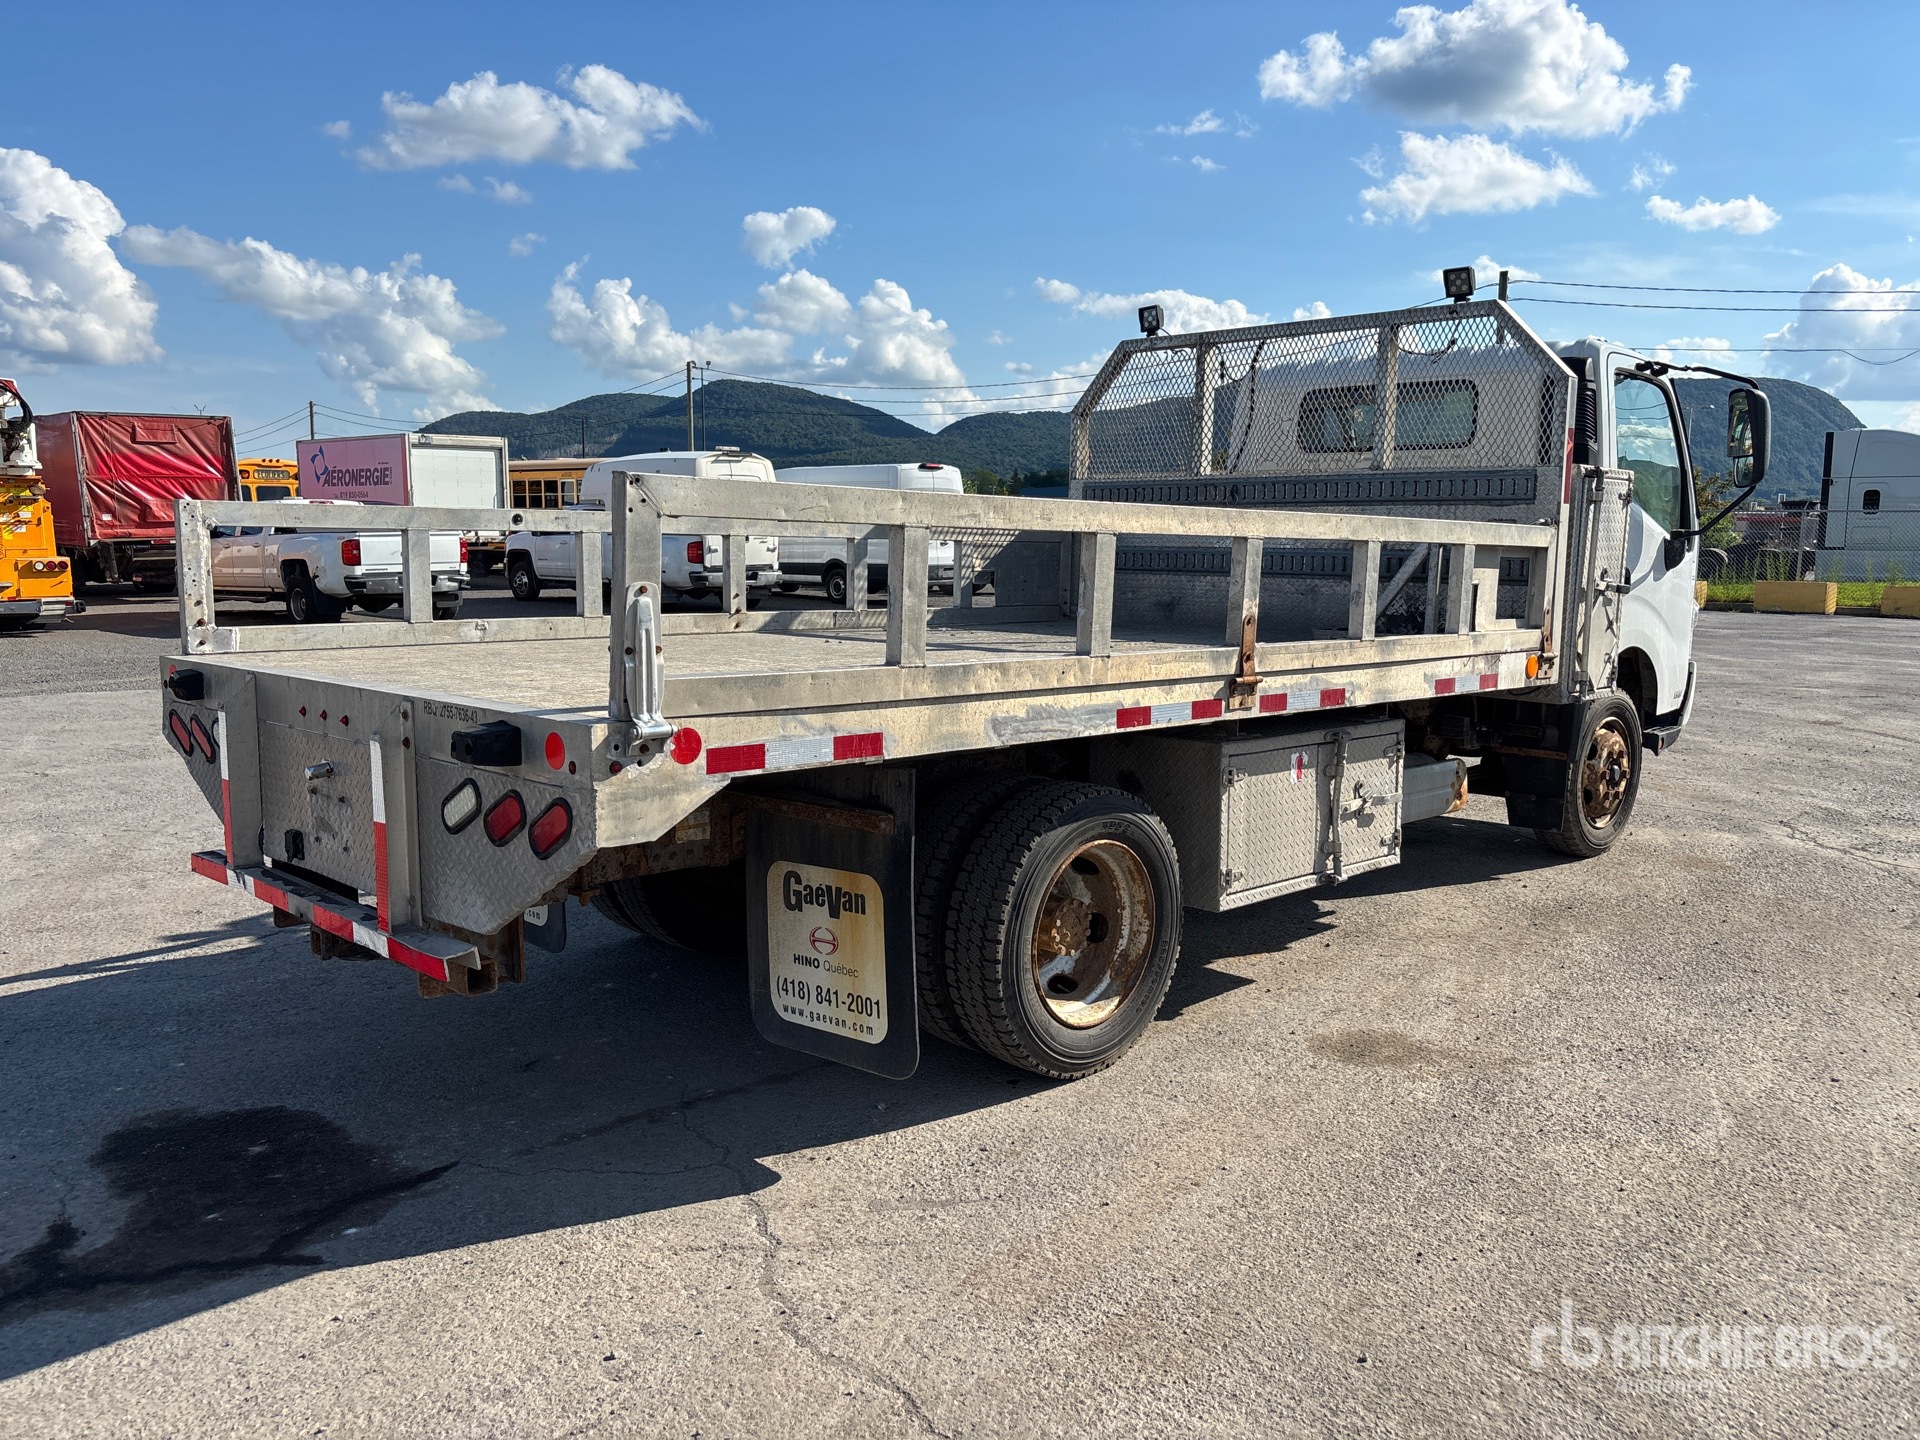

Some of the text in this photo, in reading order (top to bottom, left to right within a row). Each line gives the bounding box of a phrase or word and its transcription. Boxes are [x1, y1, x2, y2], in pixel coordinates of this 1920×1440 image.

[322, 465, 389, 487] AÉRONERGIE
[793, 953, 859, 979] HINO Québec
[776, 975, 881, 1020] (418) 841-2001
[782, 1003, 874, 1037] www.gaevan.com
